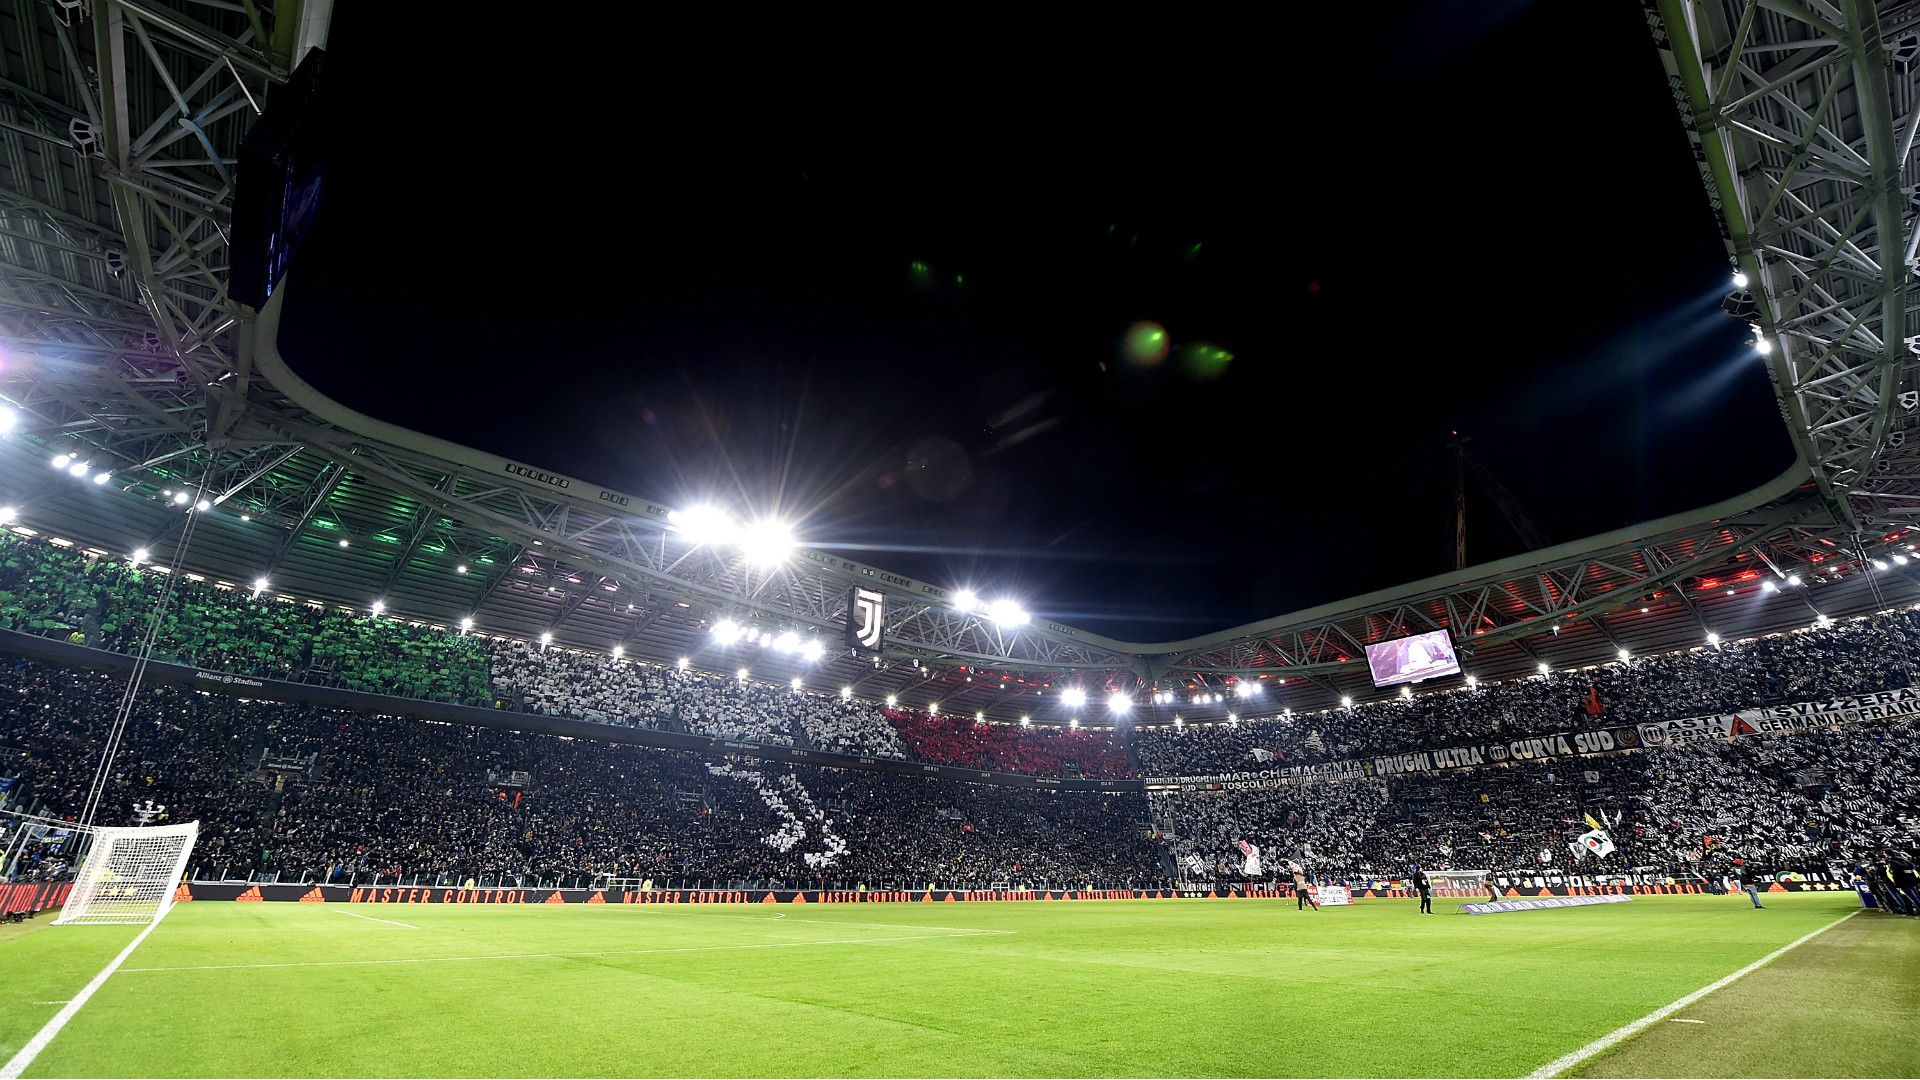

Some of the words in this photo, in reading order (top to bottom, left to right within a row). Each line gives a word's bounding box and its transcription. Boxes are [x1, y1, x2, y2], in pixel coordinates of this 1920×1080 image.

[196, 671, 222, 682] Allianz
[233, 677, 263, 687] Stadium
[1774, 688, 1916, 717] SVIZZERA
[1667, 715, 1722, 731] ASTI
[1760, 712, 1845, 732] GERMANIA
[1669, 726, 1726, 738] ZONA
[1375, 752, 1431, 776] DRUGHI
[1510, 736, 1573, 760] CURVA
[1574, 730, 1615, 753] SUD
[350, 889, 431, 903] MASTER
[444, 889, 526, 903] CONTROL
[964, 891, 996, 901] MASTER
[1001, 891, 1036, 901] CONTROL
[1567, 886, 1624, 896] MASTER
[1633, 884, 1706, 895] CONTROL
[623, 891, 681, 904] MASTER
[689, 891, 748, 904] CONTROL
[818, 892, 861, 903] MASTER
[867, 892, 912, 903] CONTROL
